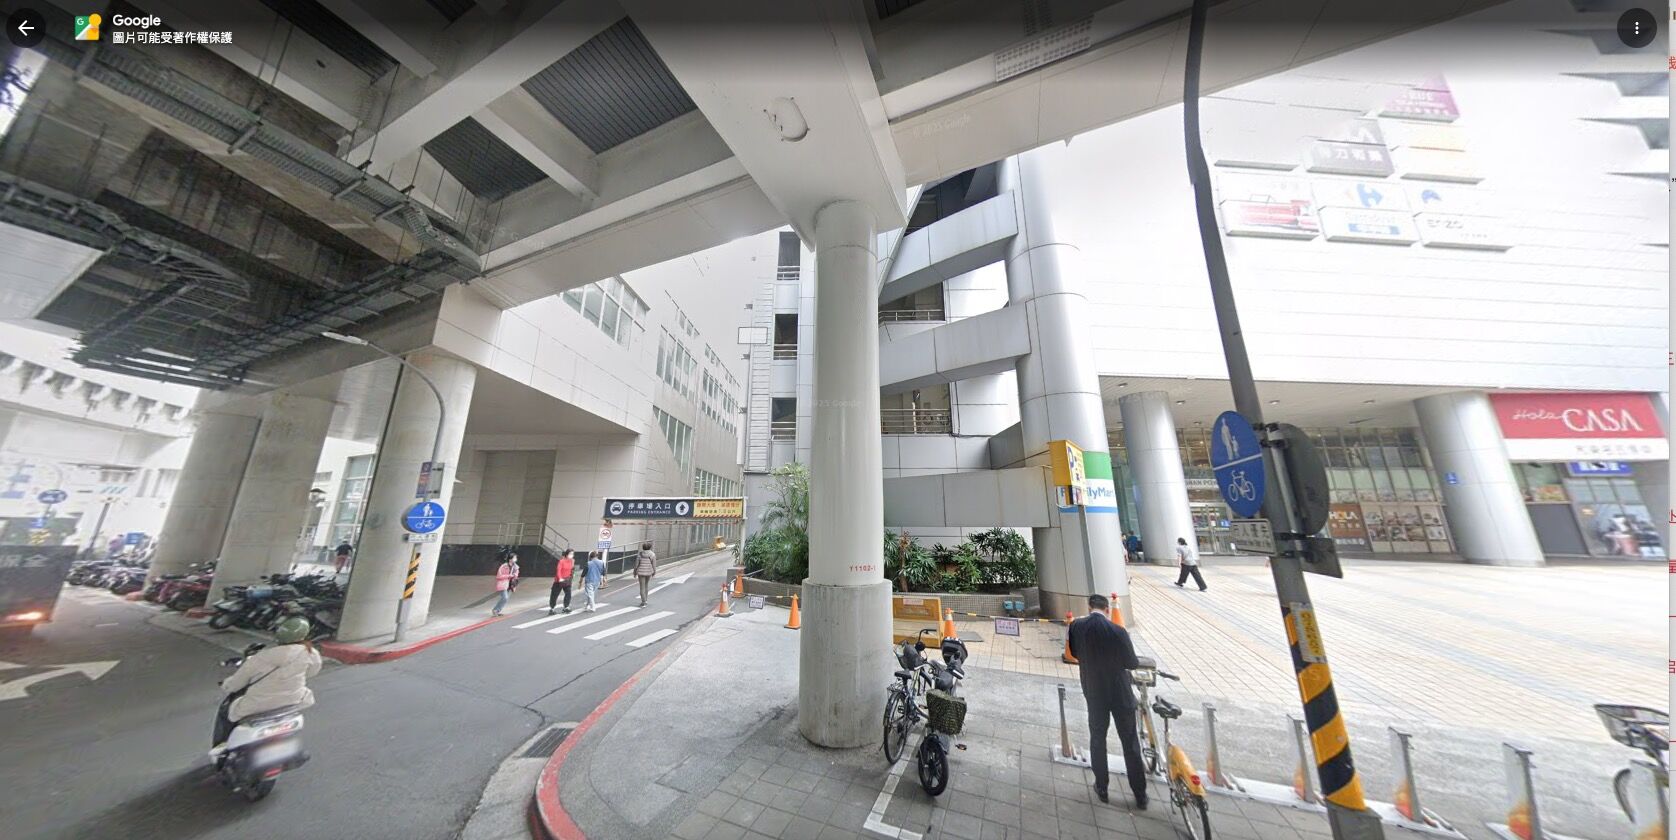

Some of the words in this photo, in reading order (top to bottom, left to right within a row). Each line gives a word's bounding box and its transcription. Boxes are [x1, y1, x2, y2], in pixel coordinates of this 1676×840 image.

[1561, 408, 1644, 432] CASA
[628, 502, 671, 510] 停車場入口
[1328, 510, 1359, 520] HOLA
